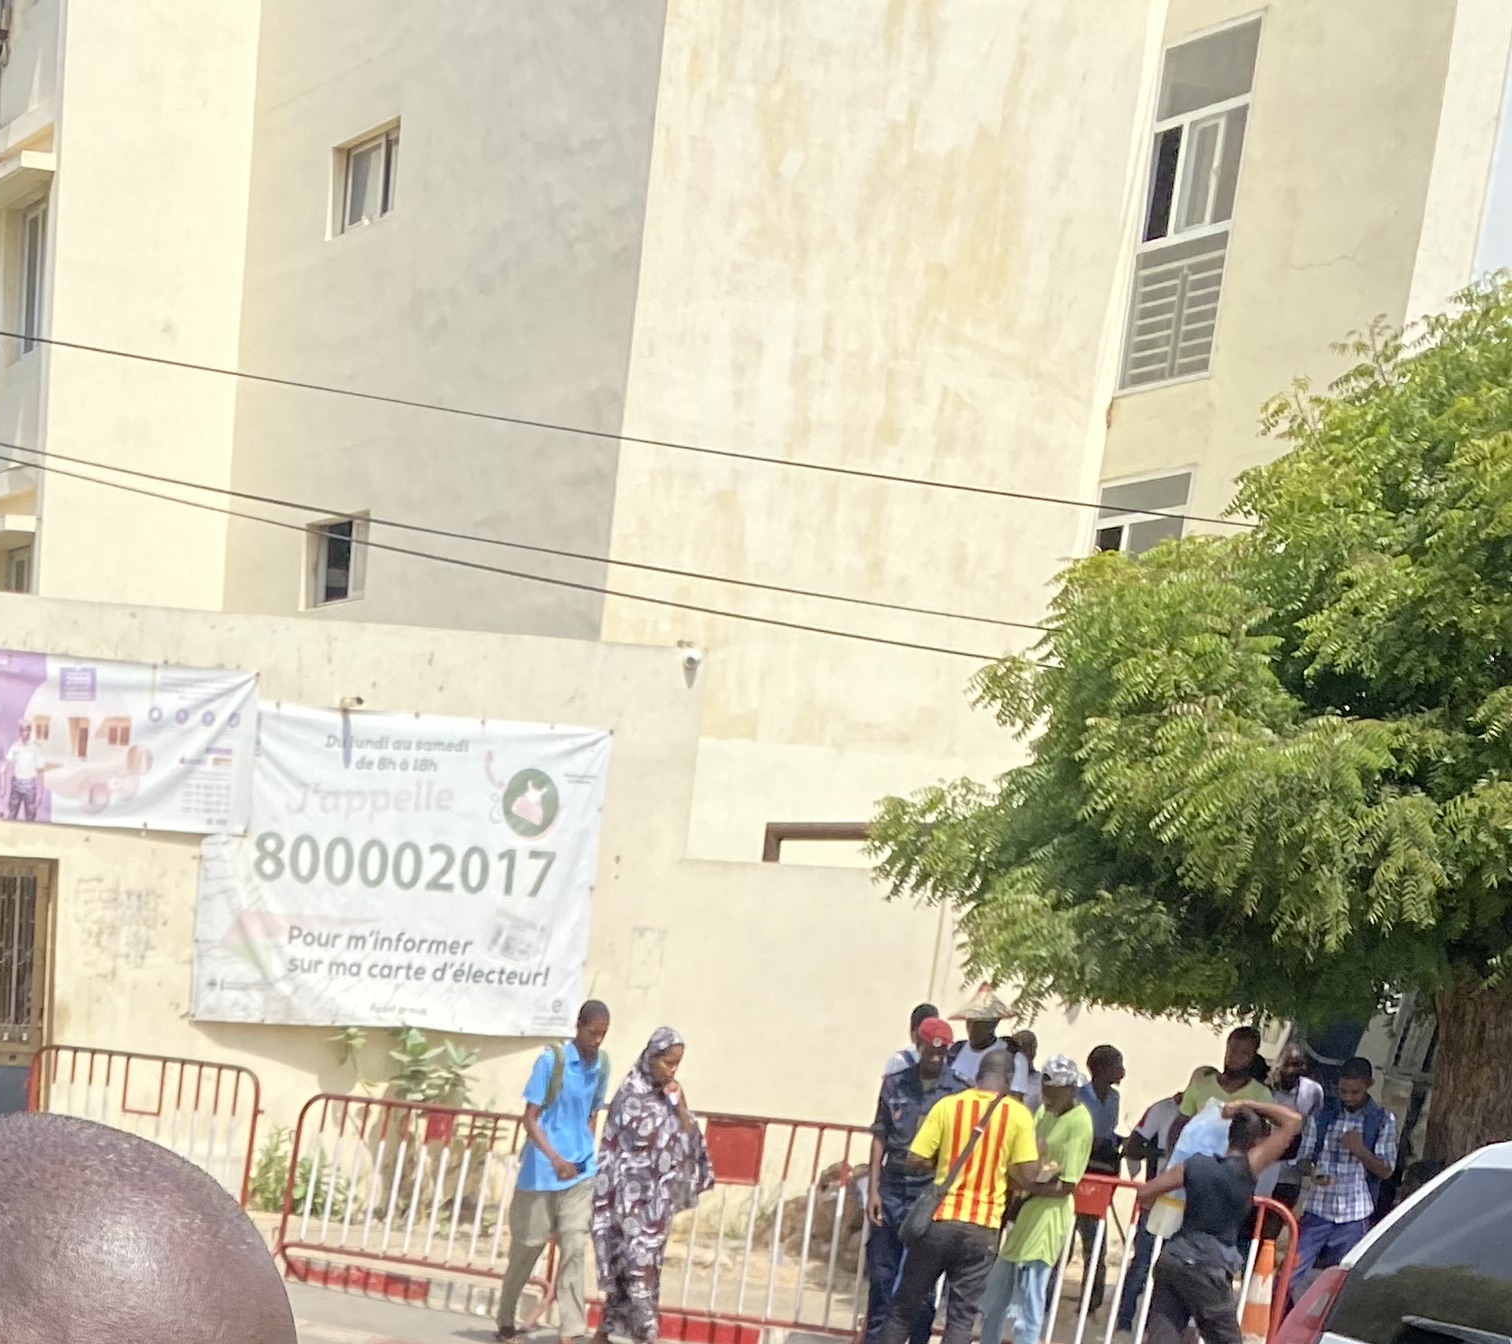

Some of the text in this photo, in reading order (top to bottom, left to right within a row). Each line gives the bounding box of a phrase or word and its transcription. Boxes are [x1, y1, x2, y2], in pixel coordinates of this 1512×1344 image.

[391, 739, 412, 750] au
[414, 739, 469, 752] samedi
[355, 757, 374, 770] de
[376, 757, 396, 771] 8h
[412, 758, 438, 772] 18h
[286, 780, 454, 823] J'appelle
[254, 831, 556, 897] 800002017
[289, 926, 473, 955] Pour m'informer
[287, 957, 550, 988] sur ma carte d'électeur!
